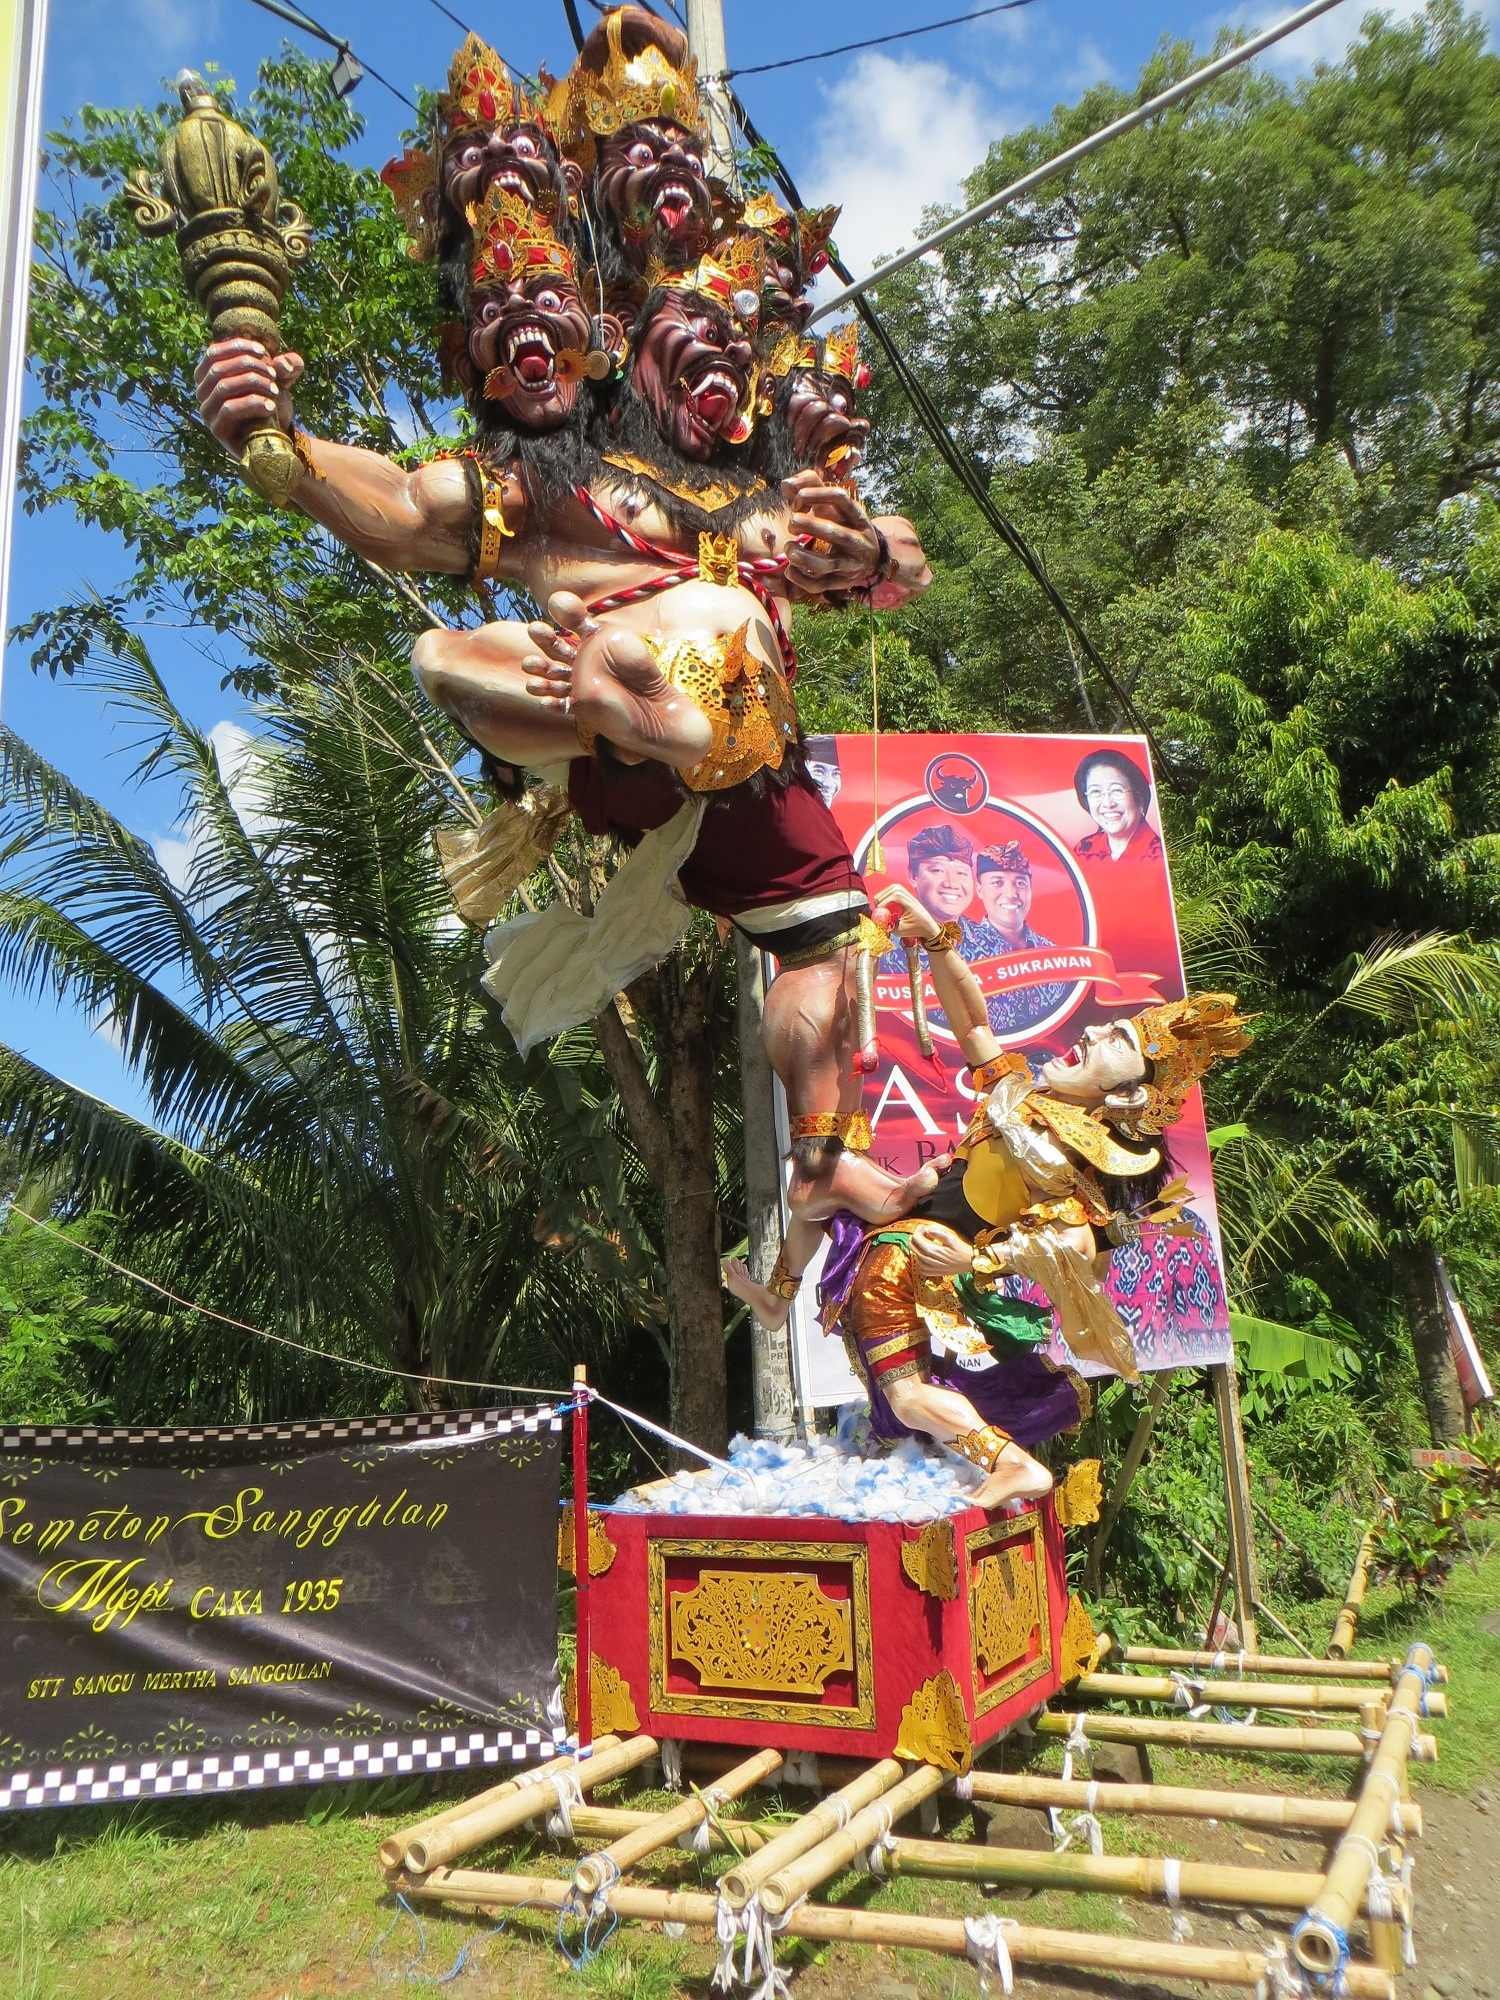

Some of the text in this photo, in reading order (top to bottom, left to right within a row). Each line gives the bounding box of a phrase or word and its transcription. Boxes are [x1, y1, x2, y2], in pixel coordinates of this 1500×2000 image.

[996, 956, 1092, 980] SUKRAWAN
[170, 1487, 449, 1549] Sanggulan
[37, 1558, 344, 1633] Nyepi CAKA 1935
[28, 1661, 333, 1700] STT SANGU MERTHA SANGGULAN
